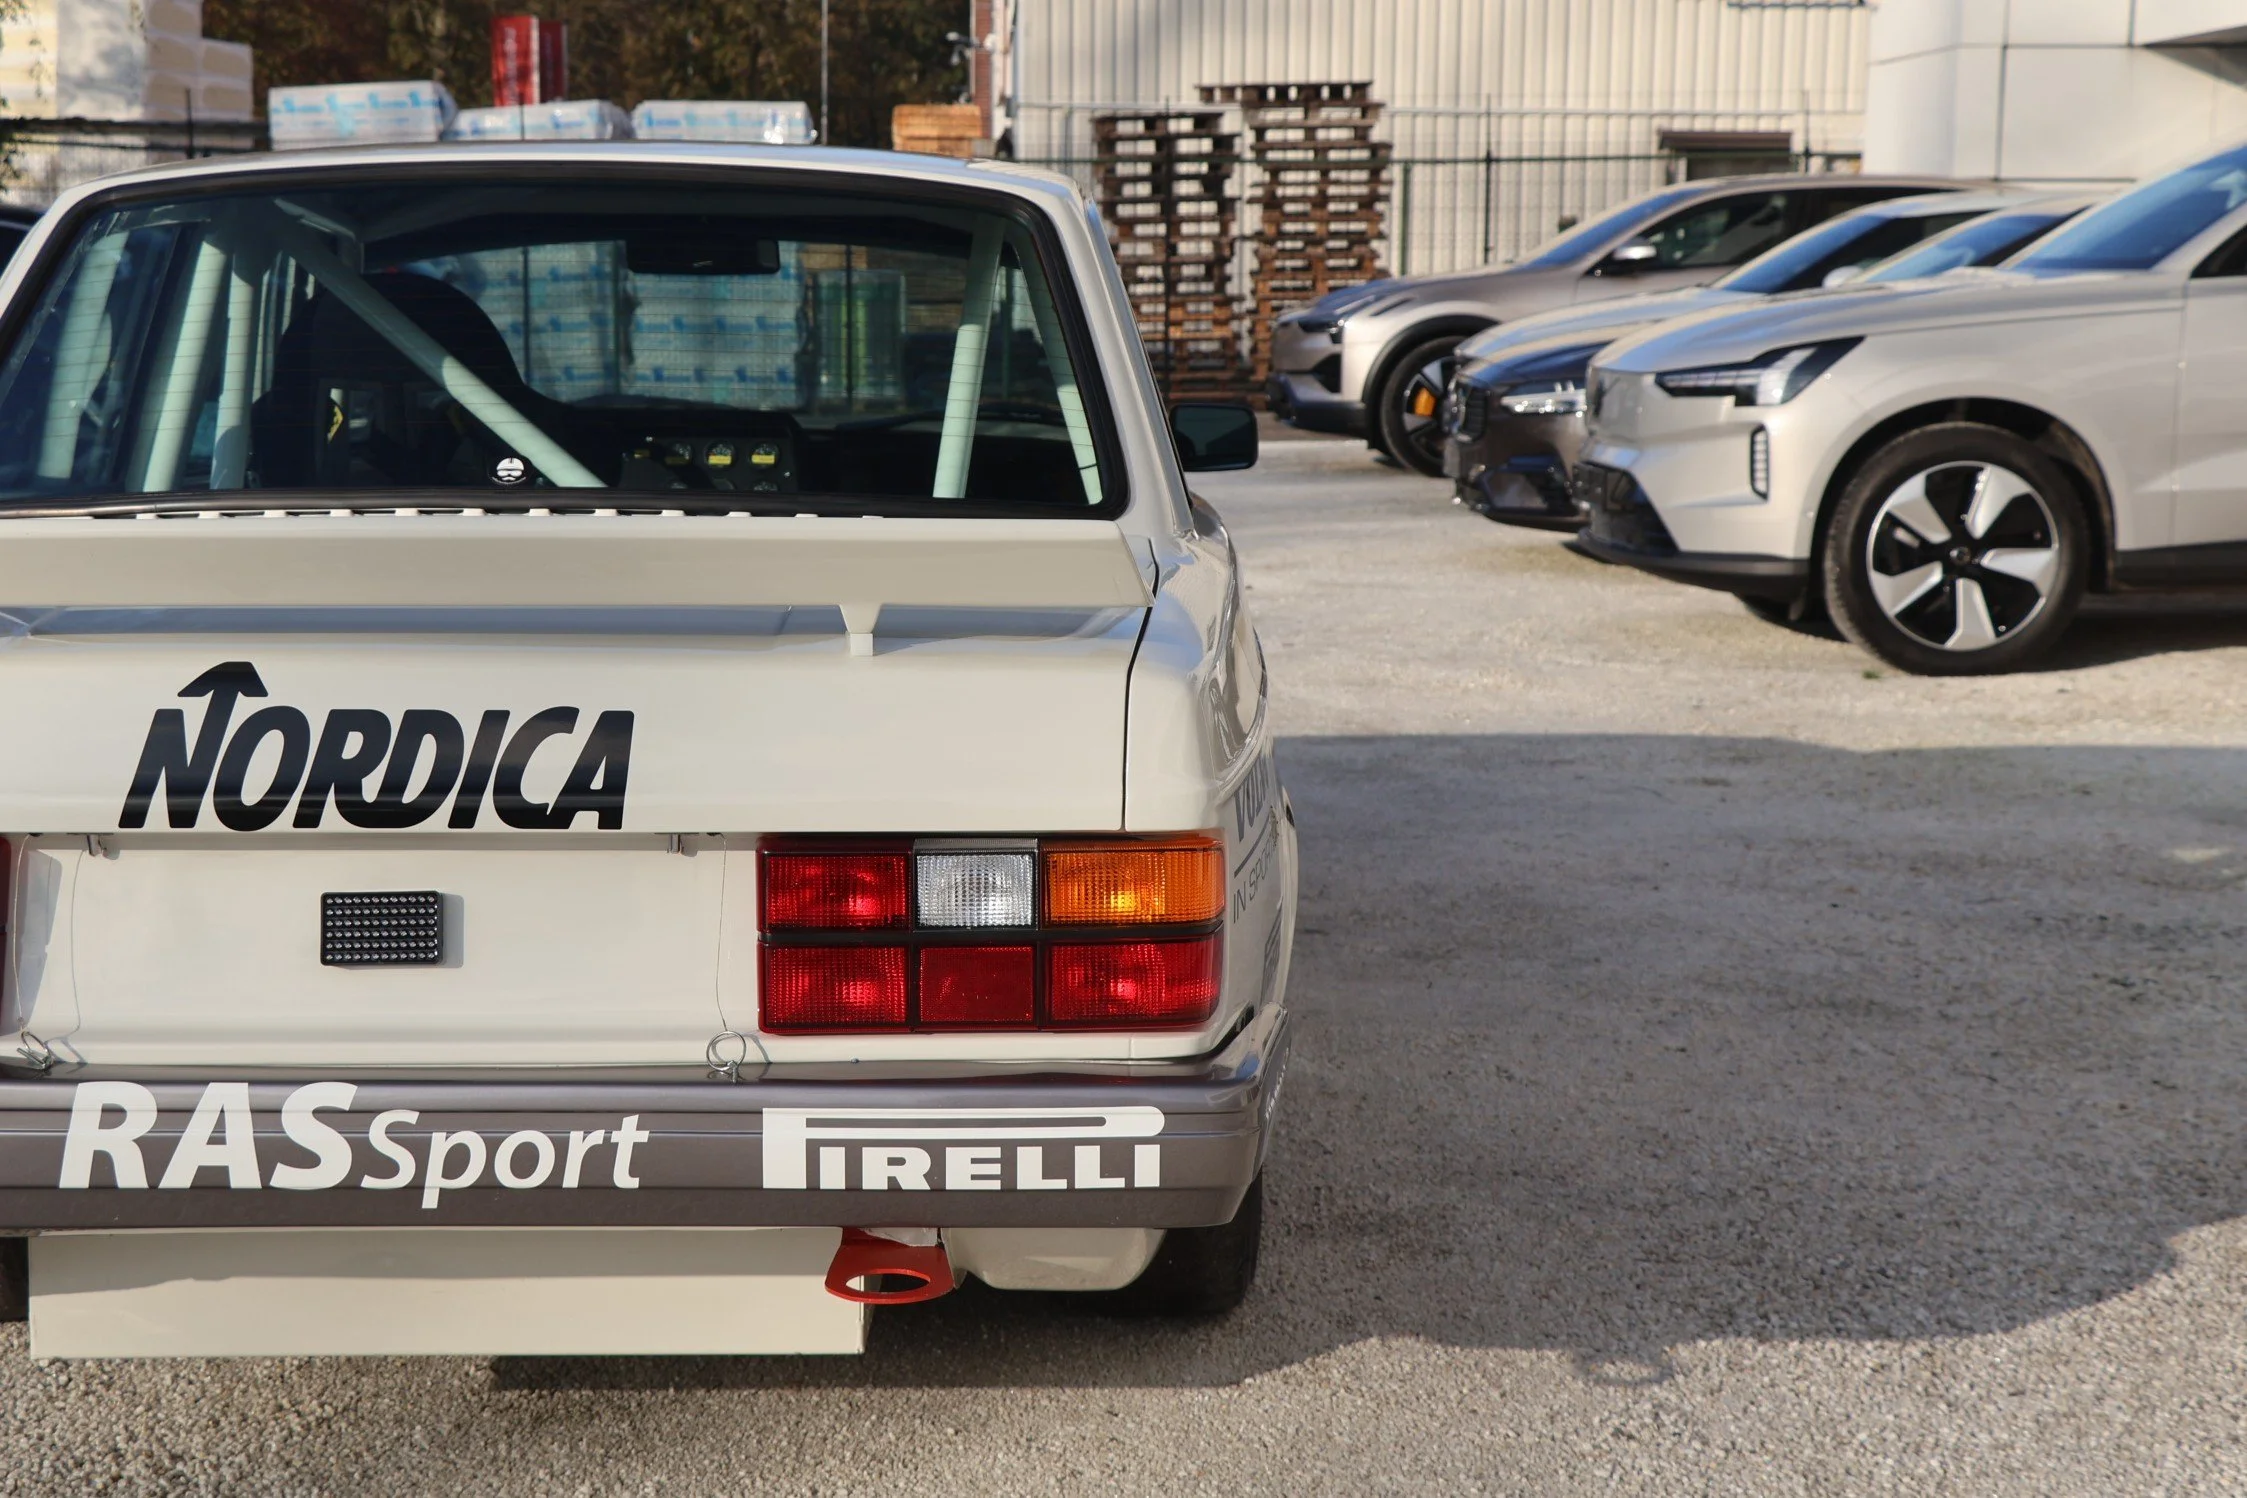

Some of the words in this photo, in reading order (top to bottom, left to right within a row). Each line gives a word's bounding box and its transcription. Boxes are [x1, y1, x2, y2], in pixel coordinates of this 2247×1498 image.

[118, 661, 635, 832] NORDICA
[1233, 881, 1247, 925] IN
[763, 1105, 1165, 1190] PIRELLI
